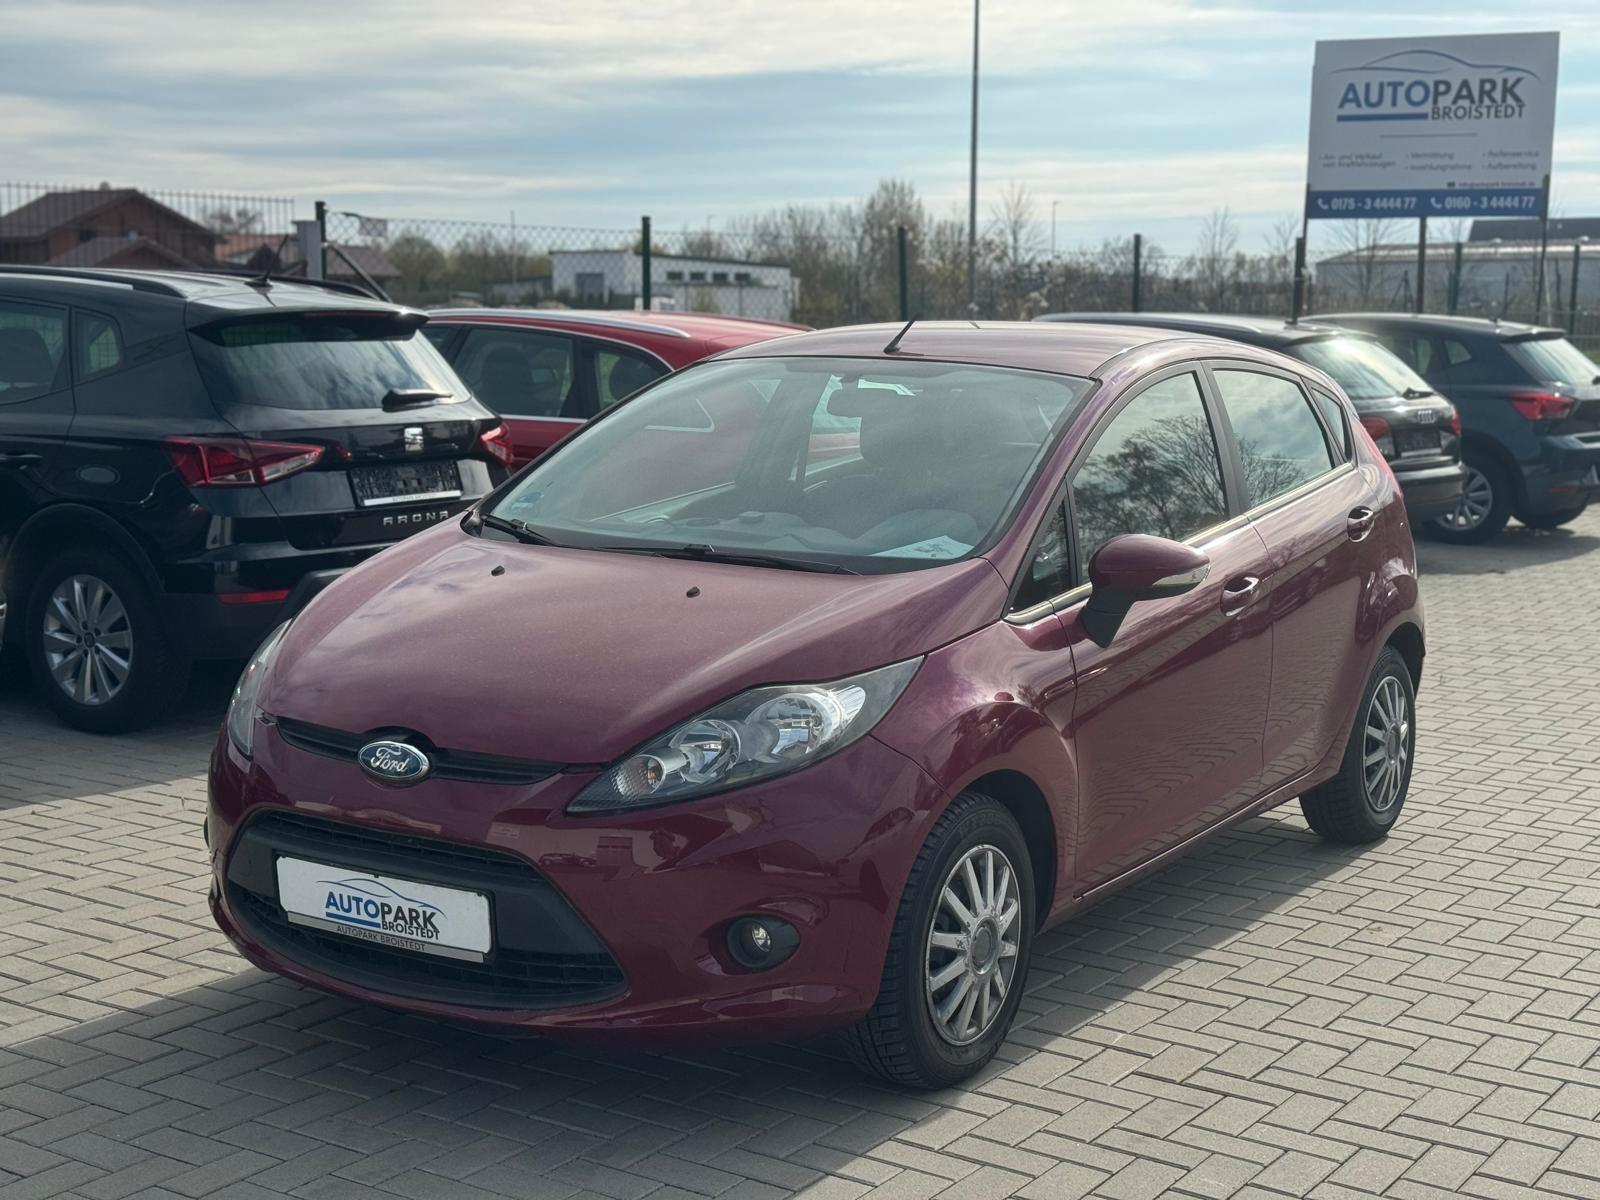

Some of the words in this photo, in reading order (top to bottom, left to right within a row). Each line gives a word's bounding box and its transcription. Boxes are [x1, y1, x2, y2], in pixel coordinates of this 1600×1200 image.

[1338, 77, 1526, 109] AUTOPARK
[1431, 104, 1526, 120] BROISTEDT
[383, 510, 449, 526] ARONA
[370, 744, 411, 773] Ford
[325, 891, 440, 932] AUTOPARK
[336, 925, 379, 941] AUTOPARK
[380, 935, 427, 951] BROISTEDT
[381, 920, 441, 940] BROISTEDT
